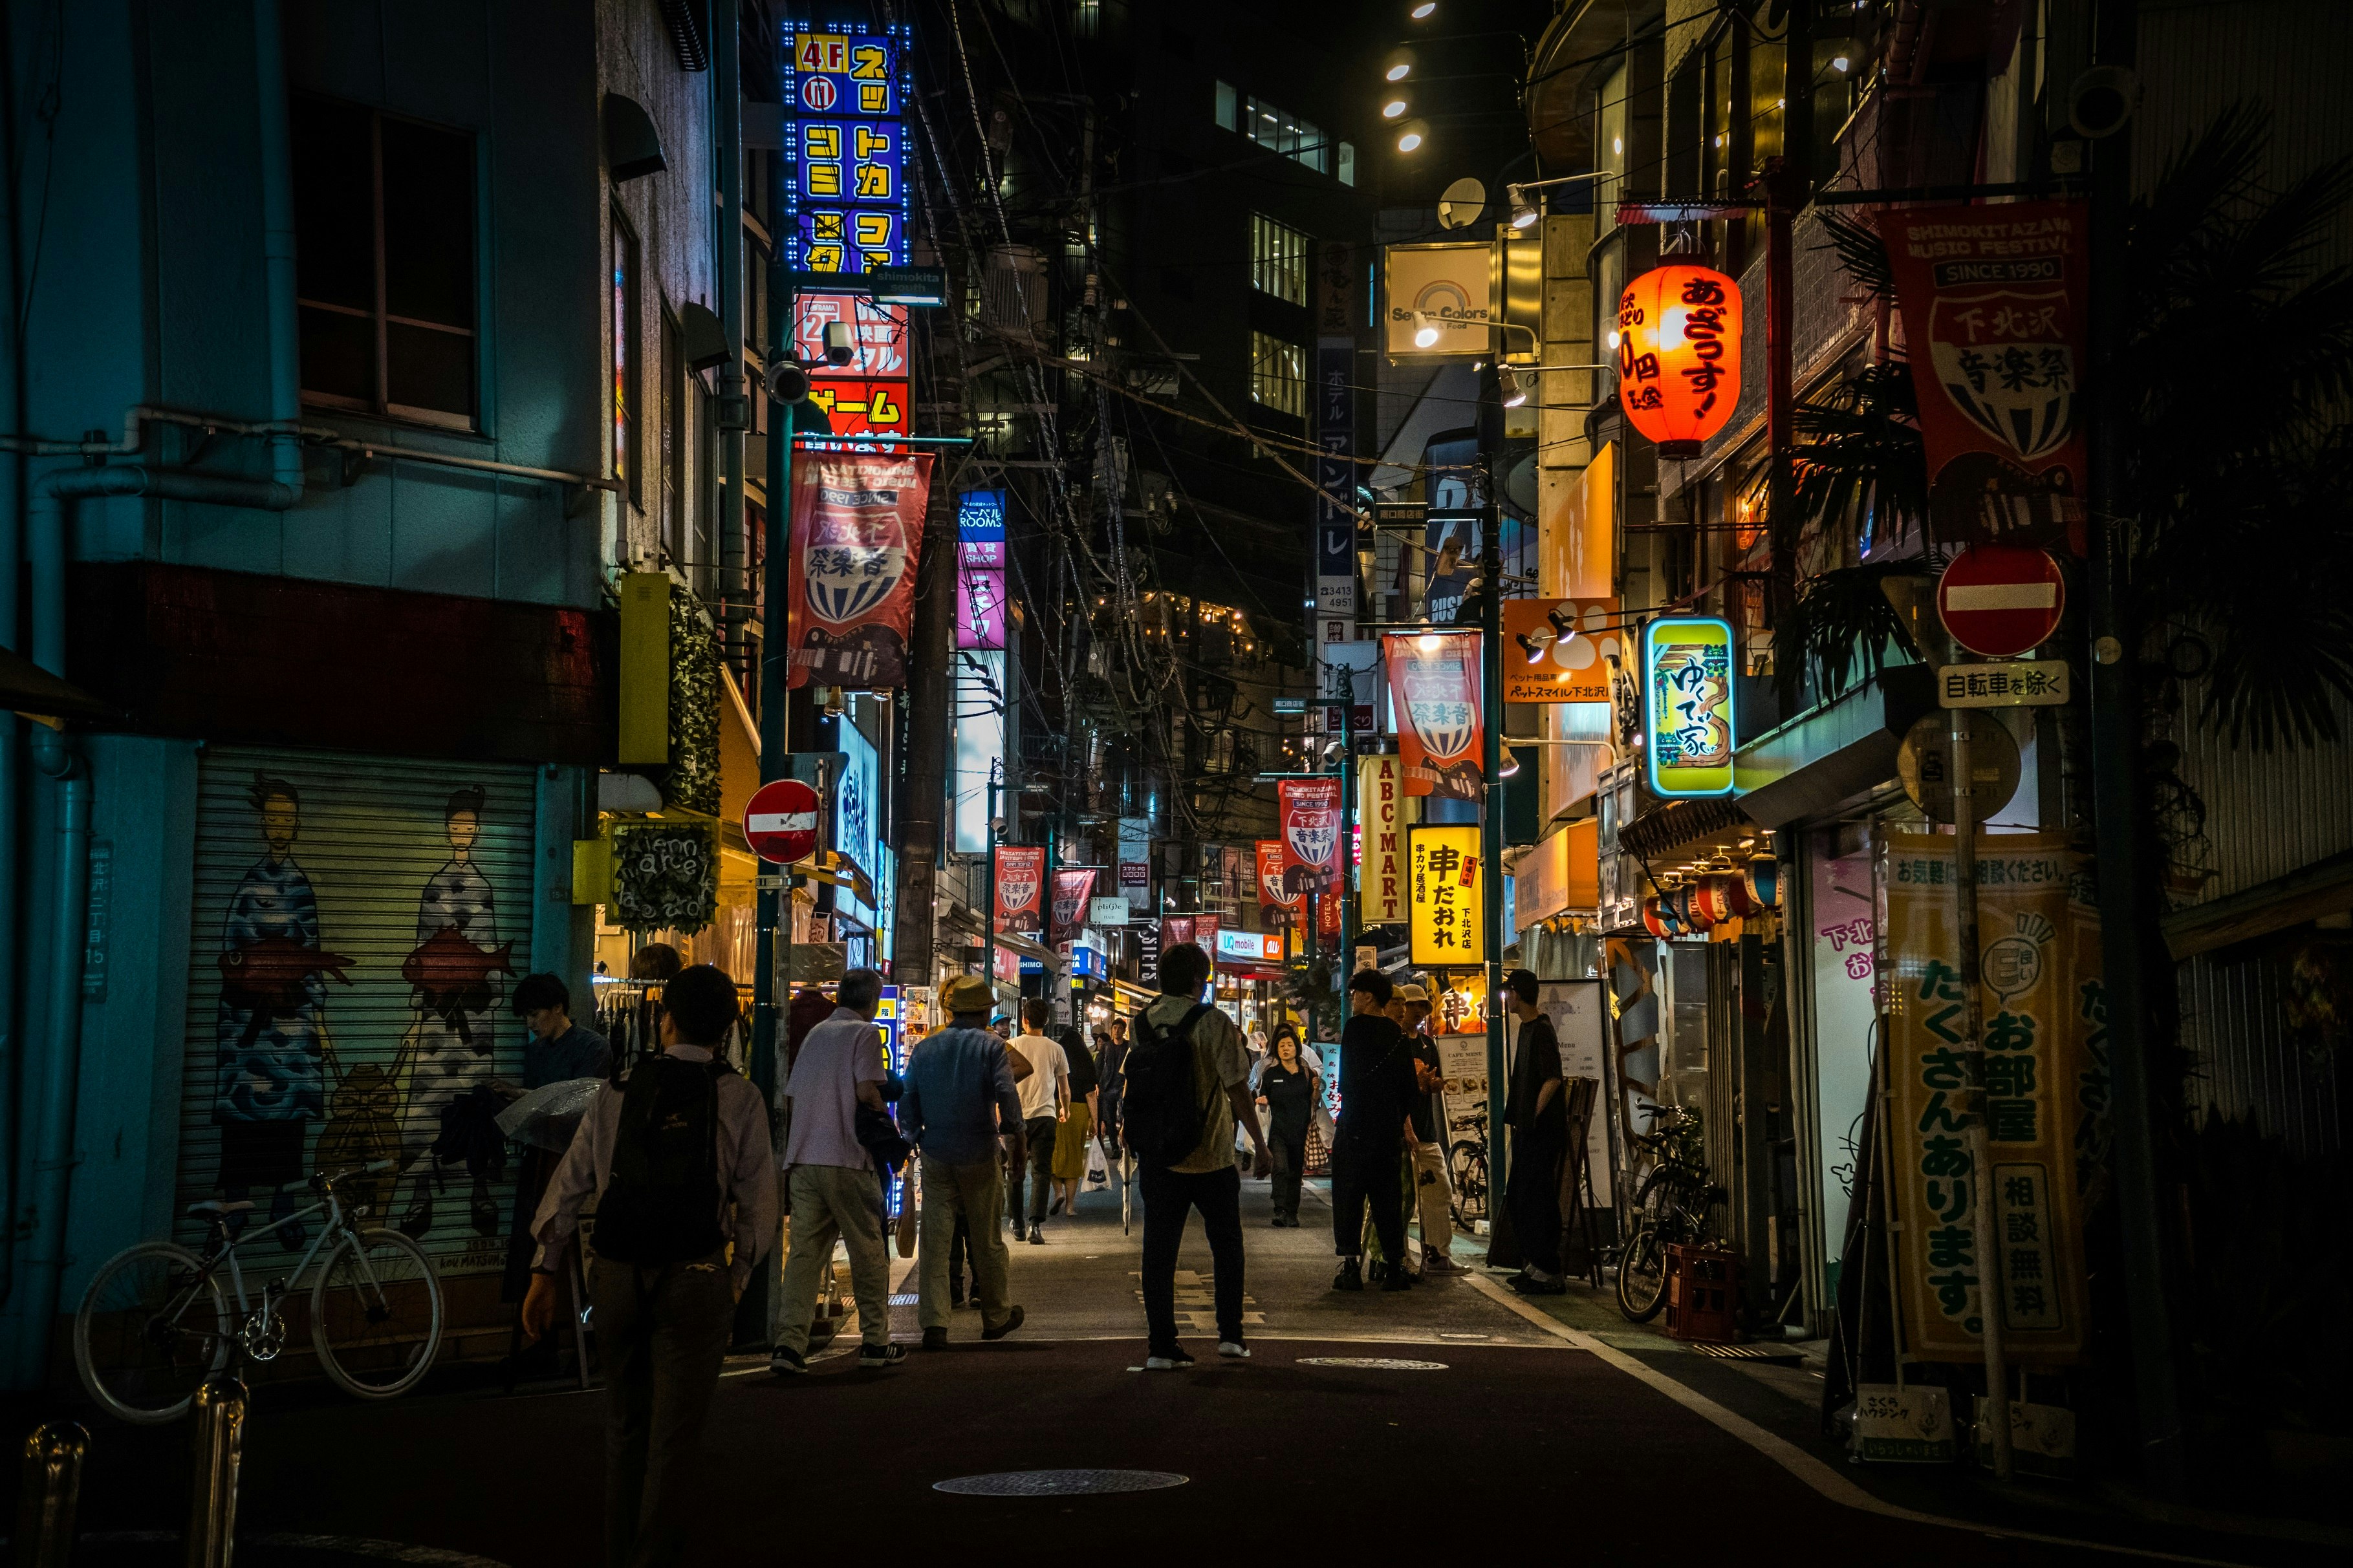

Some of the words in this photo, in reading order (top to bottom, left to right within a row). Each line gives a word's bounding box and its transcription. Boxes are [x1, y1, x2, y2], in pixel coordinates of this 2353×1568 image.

[803, 41, 844, 70] 4F
[877, 272, 939, 282] shimokita
[1946, 264, 2005, 281] SINCE
[2008, 261, 2055, 278] 1990
[1440, 306, 1488, 319] Colors
[855, 325, 892, 342] 映画
[1953, 306, 2065, 342] 下北沢
[803, 345, 902, 372] レタル
[1957, 347, 2068, 393] 音楽祭
[1328, 370, 1345, 421] ホテル
[960, 509, 1001, 518] ヘーベル
[960, 517, 1001, 527] ROOMS
[1329, 586, 1351, 595] 3413
[1510, 686, 1610, 698] ペットスマイル下北沢
[1947, 671, 2061, 696] 自転車を除く
[1298, 815, 1330, 827] 下北沢
[1296, 828, 1332, 844] 音楽祭
[1416, 844, 1426, 903] 串カツ居酒屋
[1898, 859, 2063, 883] お気軽に相談ください。
[90, 862, 104, 943] 北沢二丁目
[1428, 844, 1460, 949] 串だおれ
[1462, 908, 1471, 949] 下北沢店
[1224, 936, 1233, 950] UQ
[1235, 940, 1254, 950] mobile
[1266, 940, 1280, 954] au
[1984, 1012, 2037, 1142] お部屋
[1919, 961, 1984, 1334] たくさんあります。
[2005, 1177, 2045, 1316] 相談無料
[1860, 1408, 1909, 1419] ハウジング
[1868, 1398, 1898, 1408] さくら
